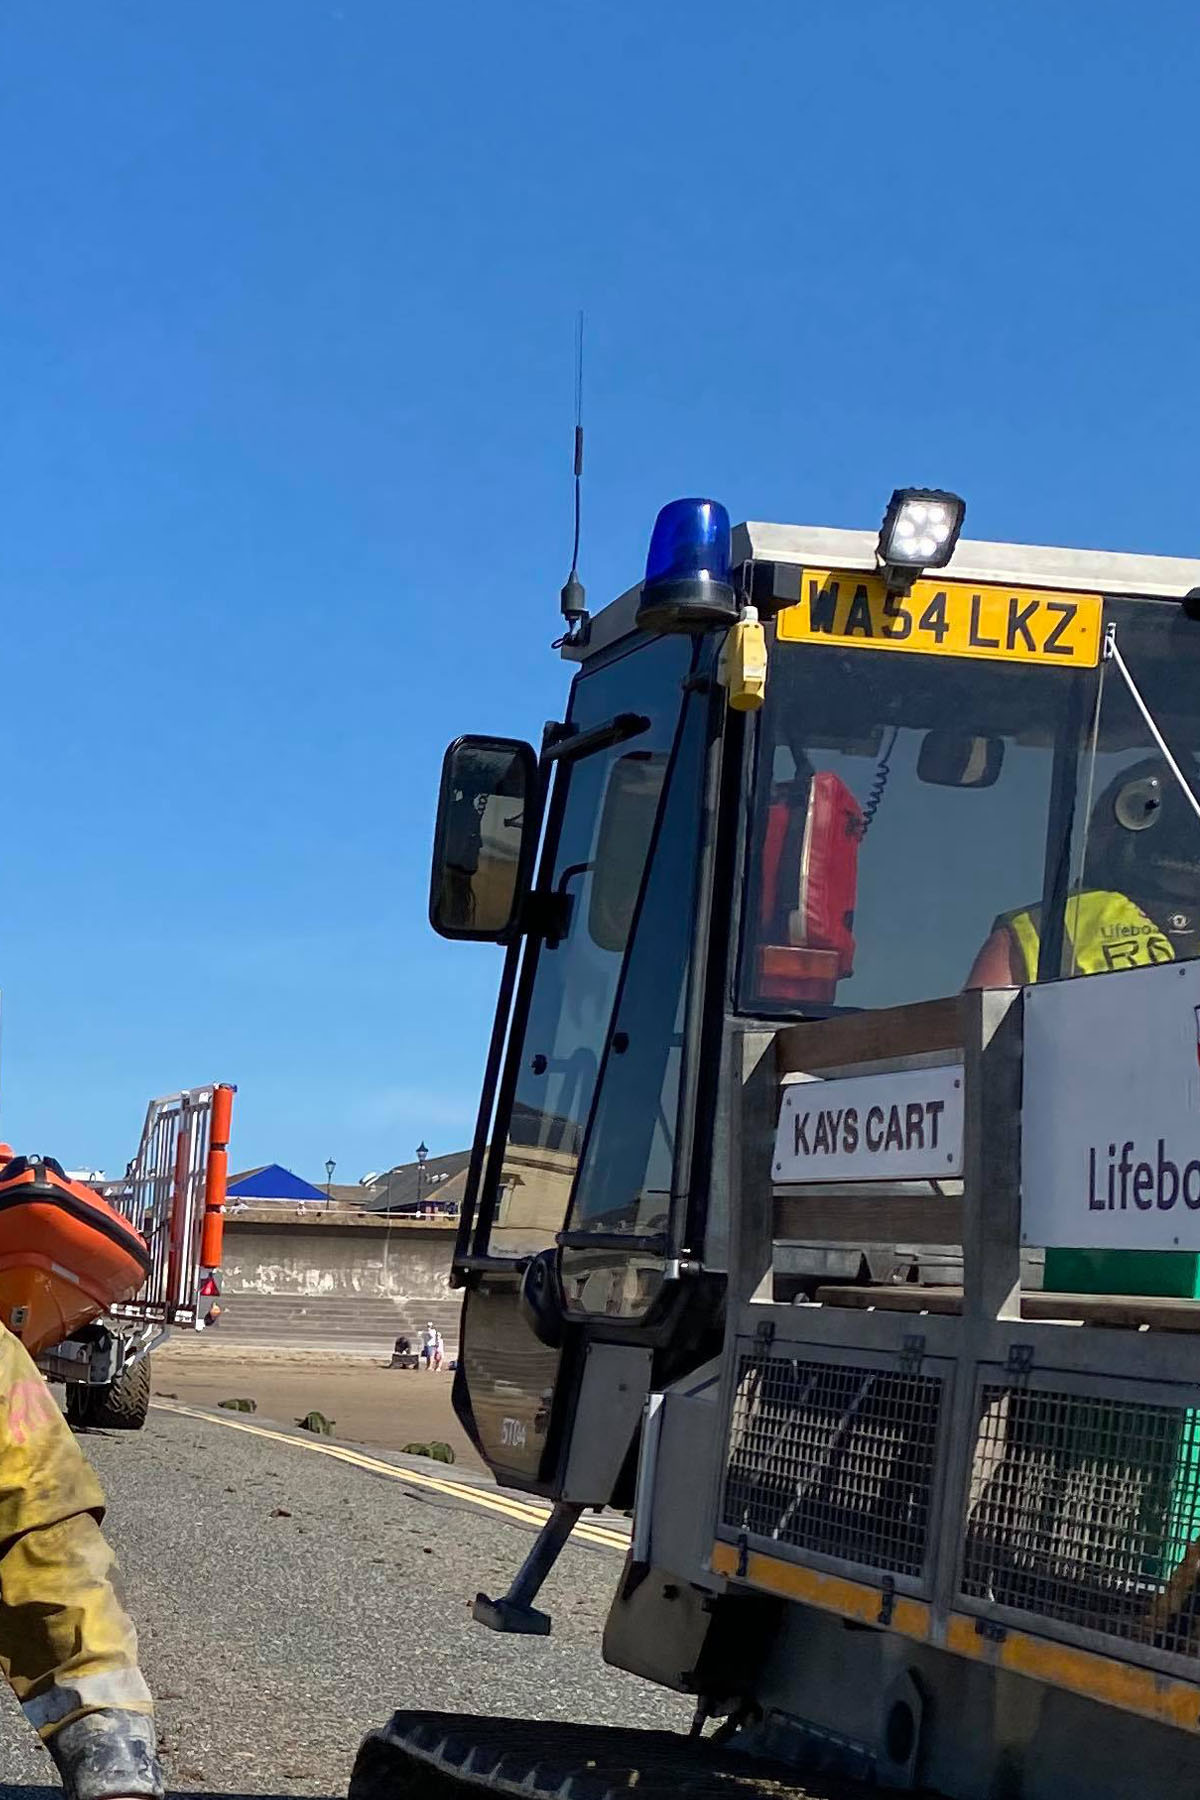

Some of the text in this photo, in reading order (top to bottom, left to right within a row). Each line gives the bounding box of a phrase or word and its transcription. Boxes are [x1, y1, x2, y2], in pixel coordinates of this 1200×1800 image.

[809, 579, 1078, 656] WA54 LKZ
[794, 1100, 945, 1157] KAYS CART
